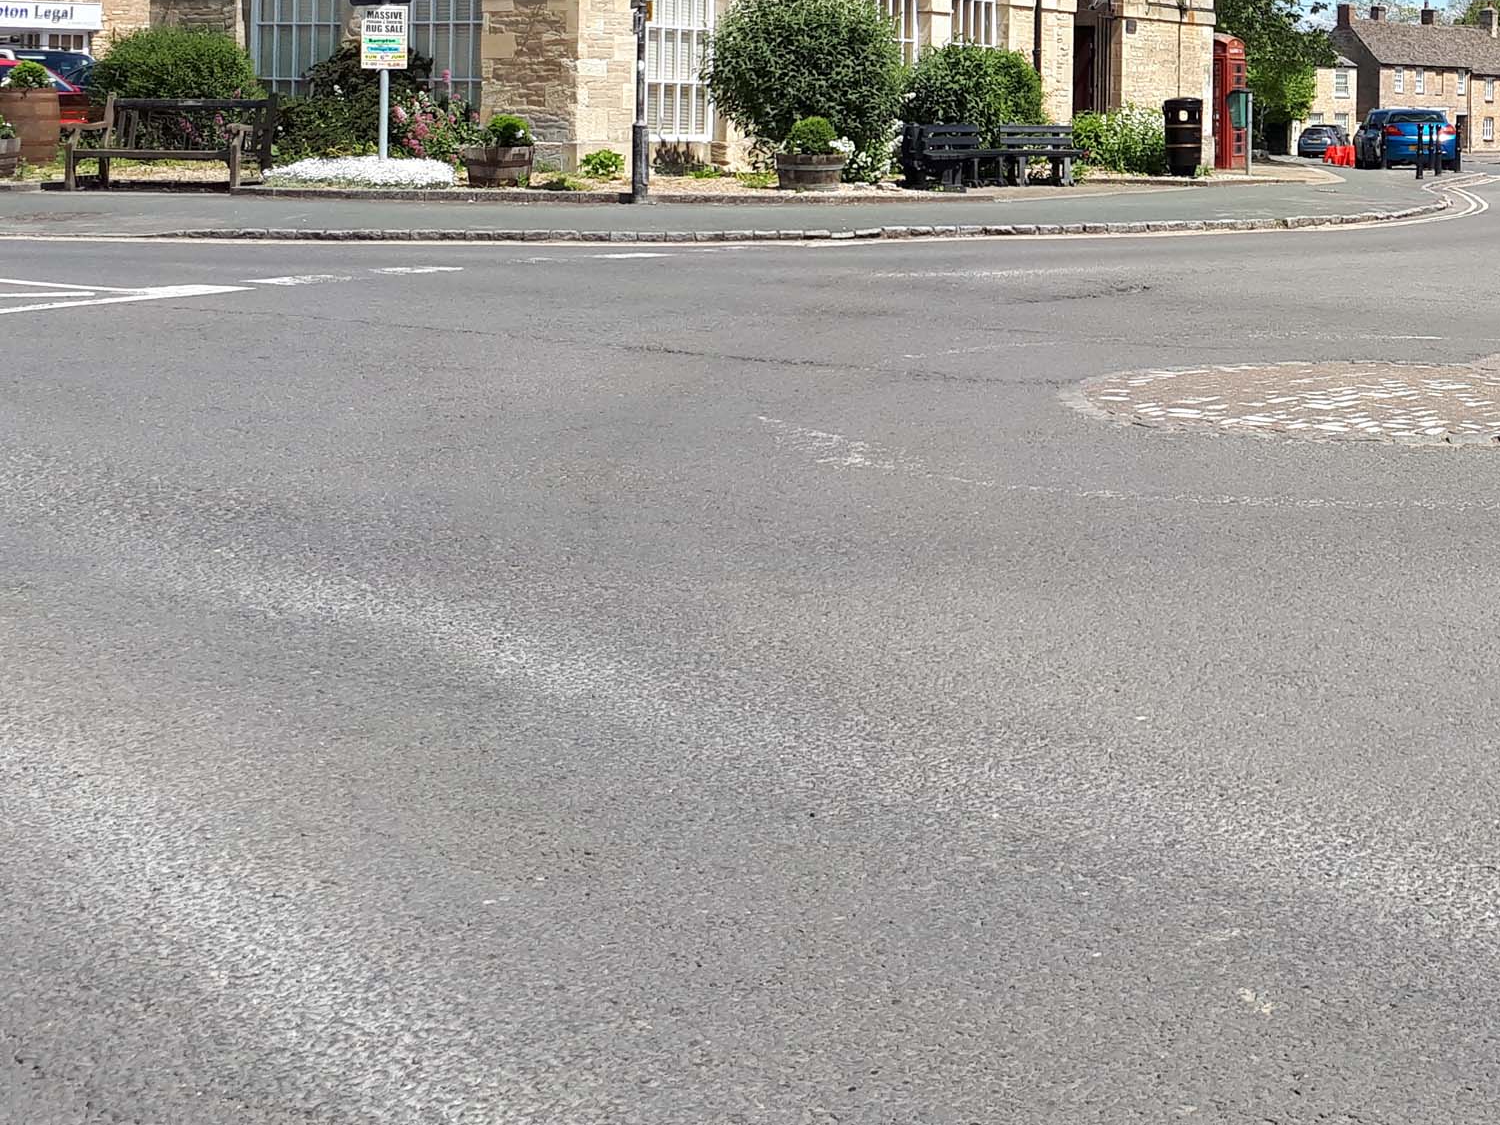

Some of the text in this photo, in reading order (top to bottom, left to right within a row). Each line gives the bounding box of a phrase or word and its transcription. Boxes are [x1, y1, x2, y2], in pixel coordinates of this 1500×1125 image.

[34, 4, 74, 23] Legal
[366, 10, 403, 20] MASSIVE
[365, 24, 403, 33] RUG SALE
